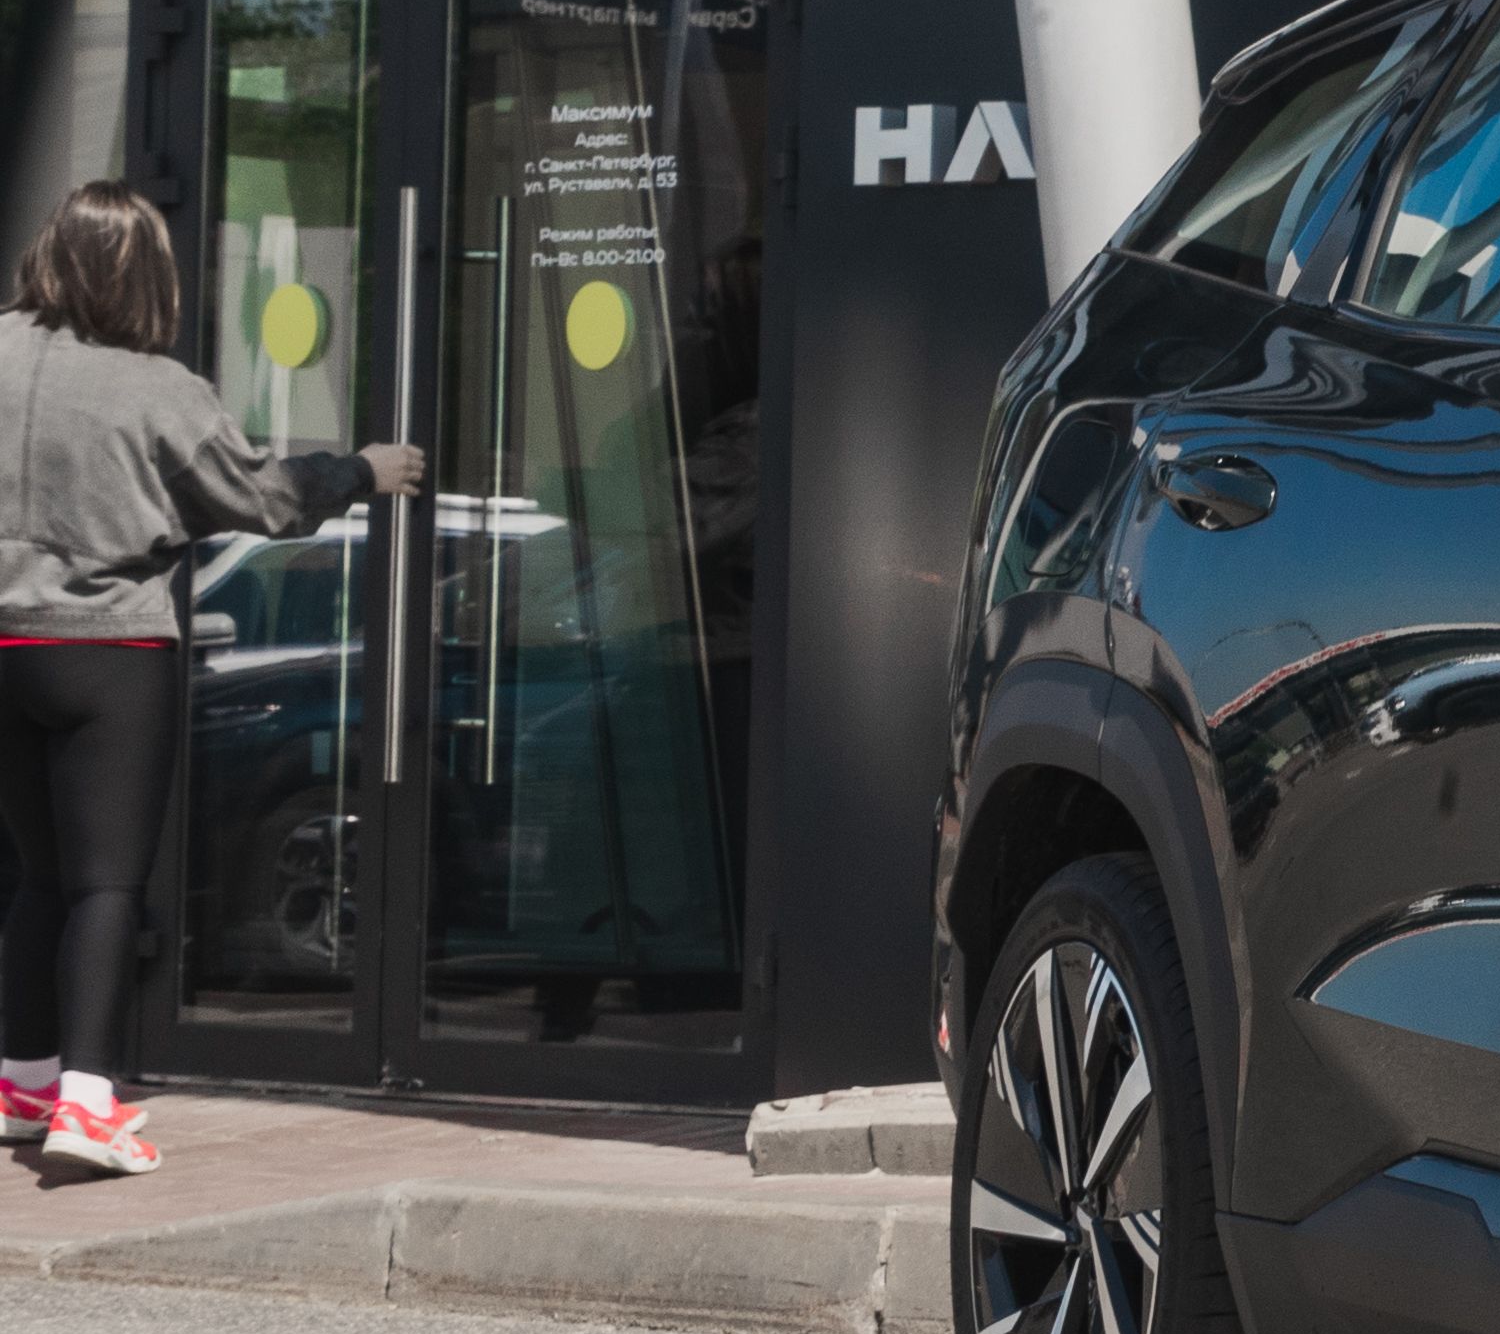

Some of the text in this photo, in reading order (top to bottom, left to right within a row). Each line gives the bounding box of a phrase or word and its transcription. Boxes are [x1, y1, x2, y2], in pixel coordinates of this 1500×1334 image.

[551, 105, 653, 122] Максимум
[574, 132, 628, 148] Адрес:
[656, 172, 677, 188] 53
[539, 226, 593, 242] Режим
[531, 251, 578, 267] Пн-Вс
